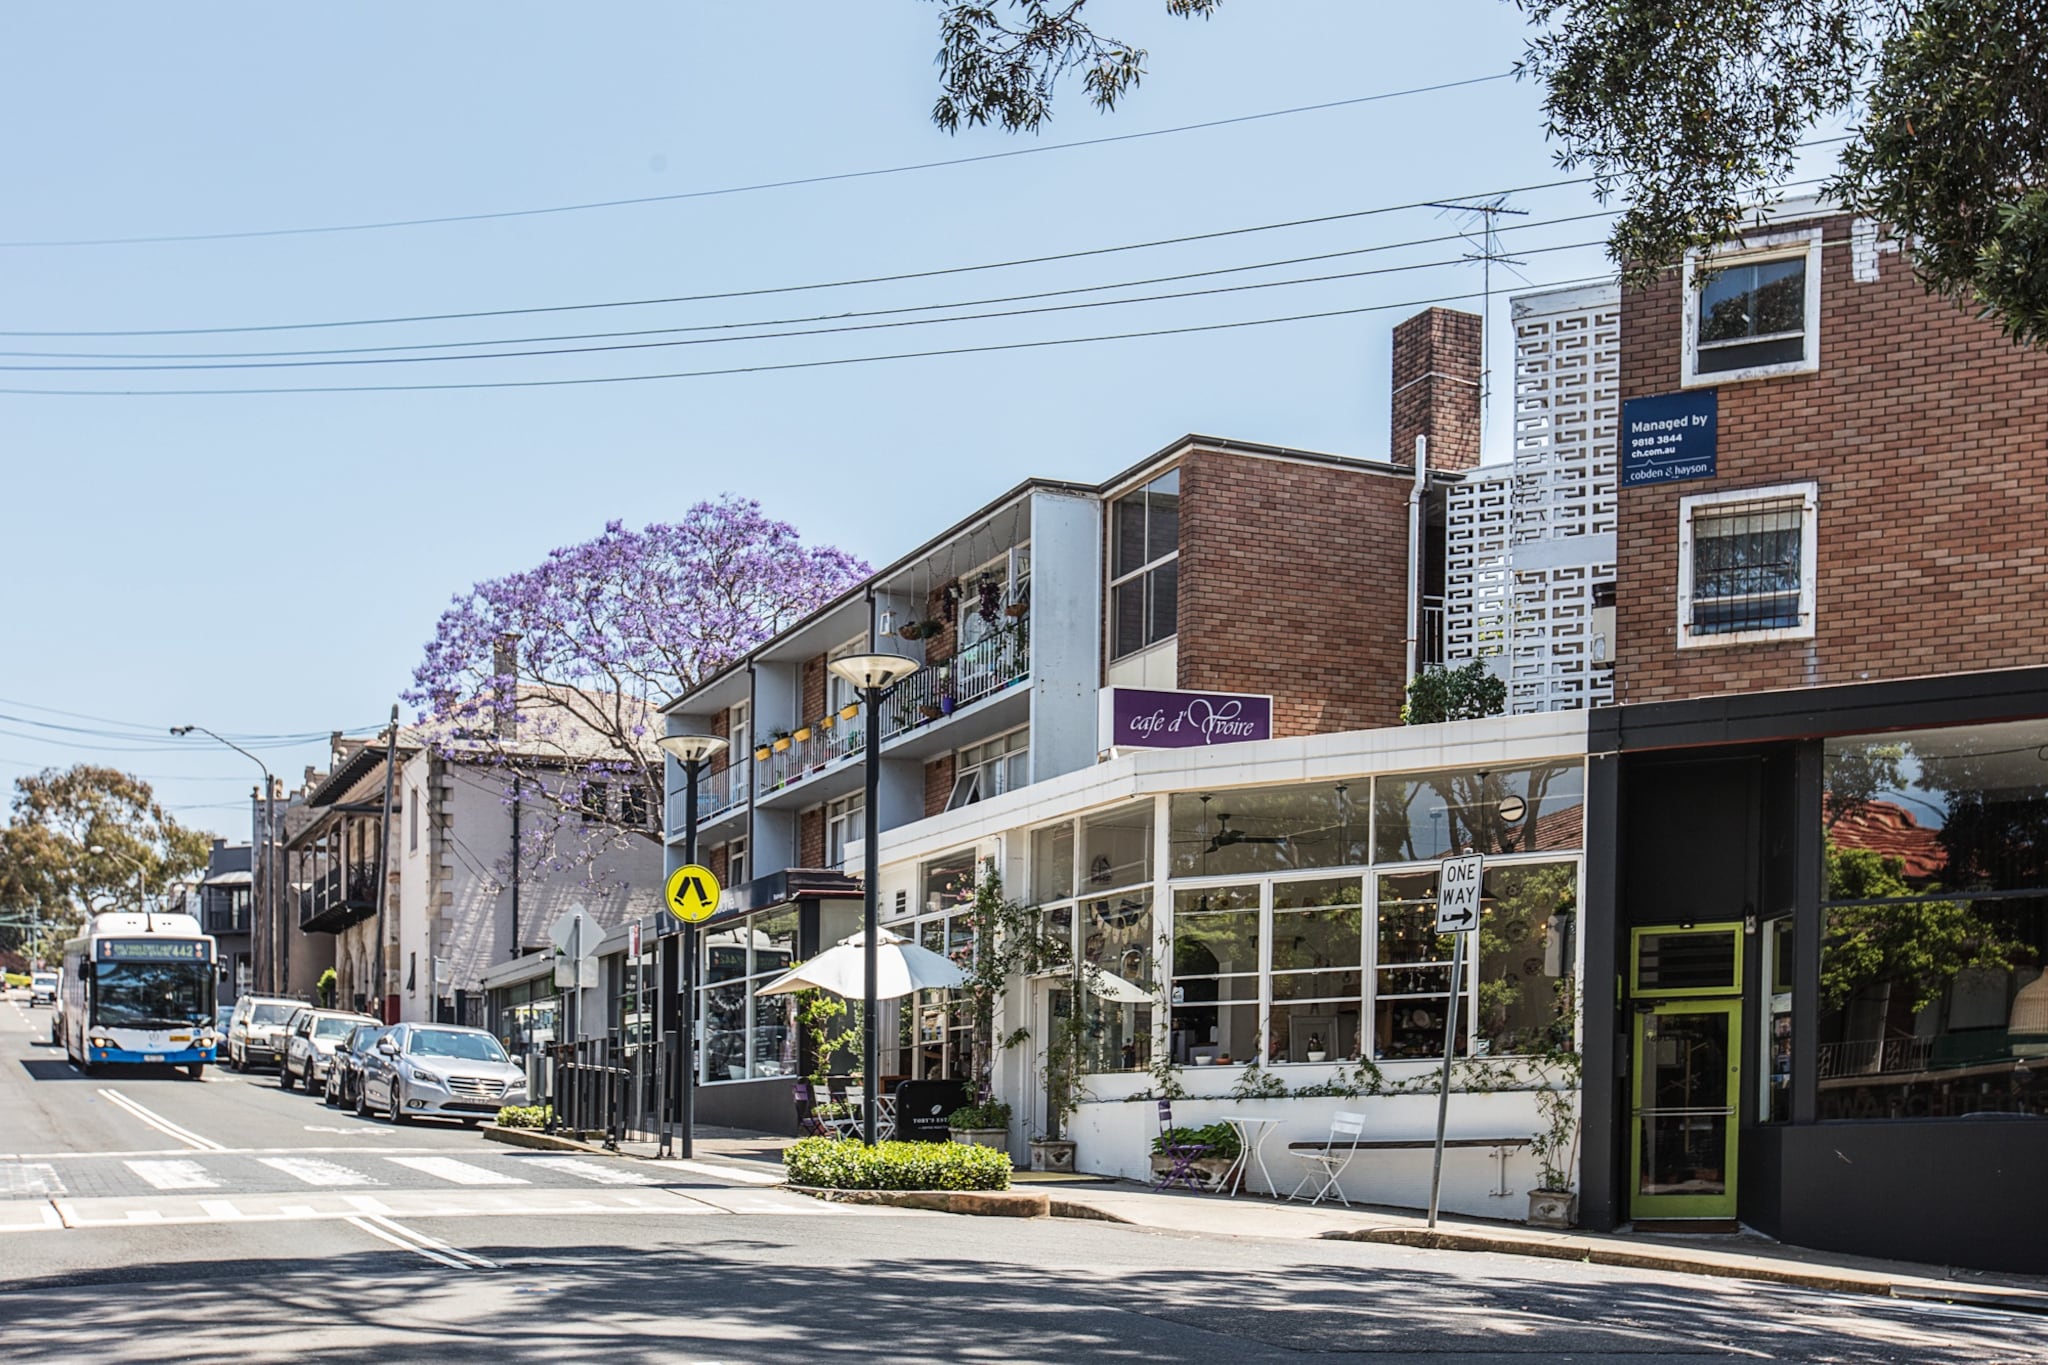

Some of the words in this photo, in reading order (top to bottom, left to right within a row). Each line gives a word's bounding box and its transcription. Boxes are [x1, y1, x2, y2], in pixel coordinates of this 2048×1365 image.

[1631, 415, 1689, 434] Managed
[1692, 414, 1708, 427] by
[1631, 437, 1655, 448] 9818
[1656, 433, 1683, 444] 3844
[1631, 446, 1676, 458] ch.com.au
[1630, 468, 1664, 481] cobden
[1674, 463, 1707, 477] hayson
[1130, 708, 1165, 739] cafe
[1447, 863, 1476, 883] ONE
[1443, 886, 1476, 906] WAY
[172, 944, 193, 956] 442
